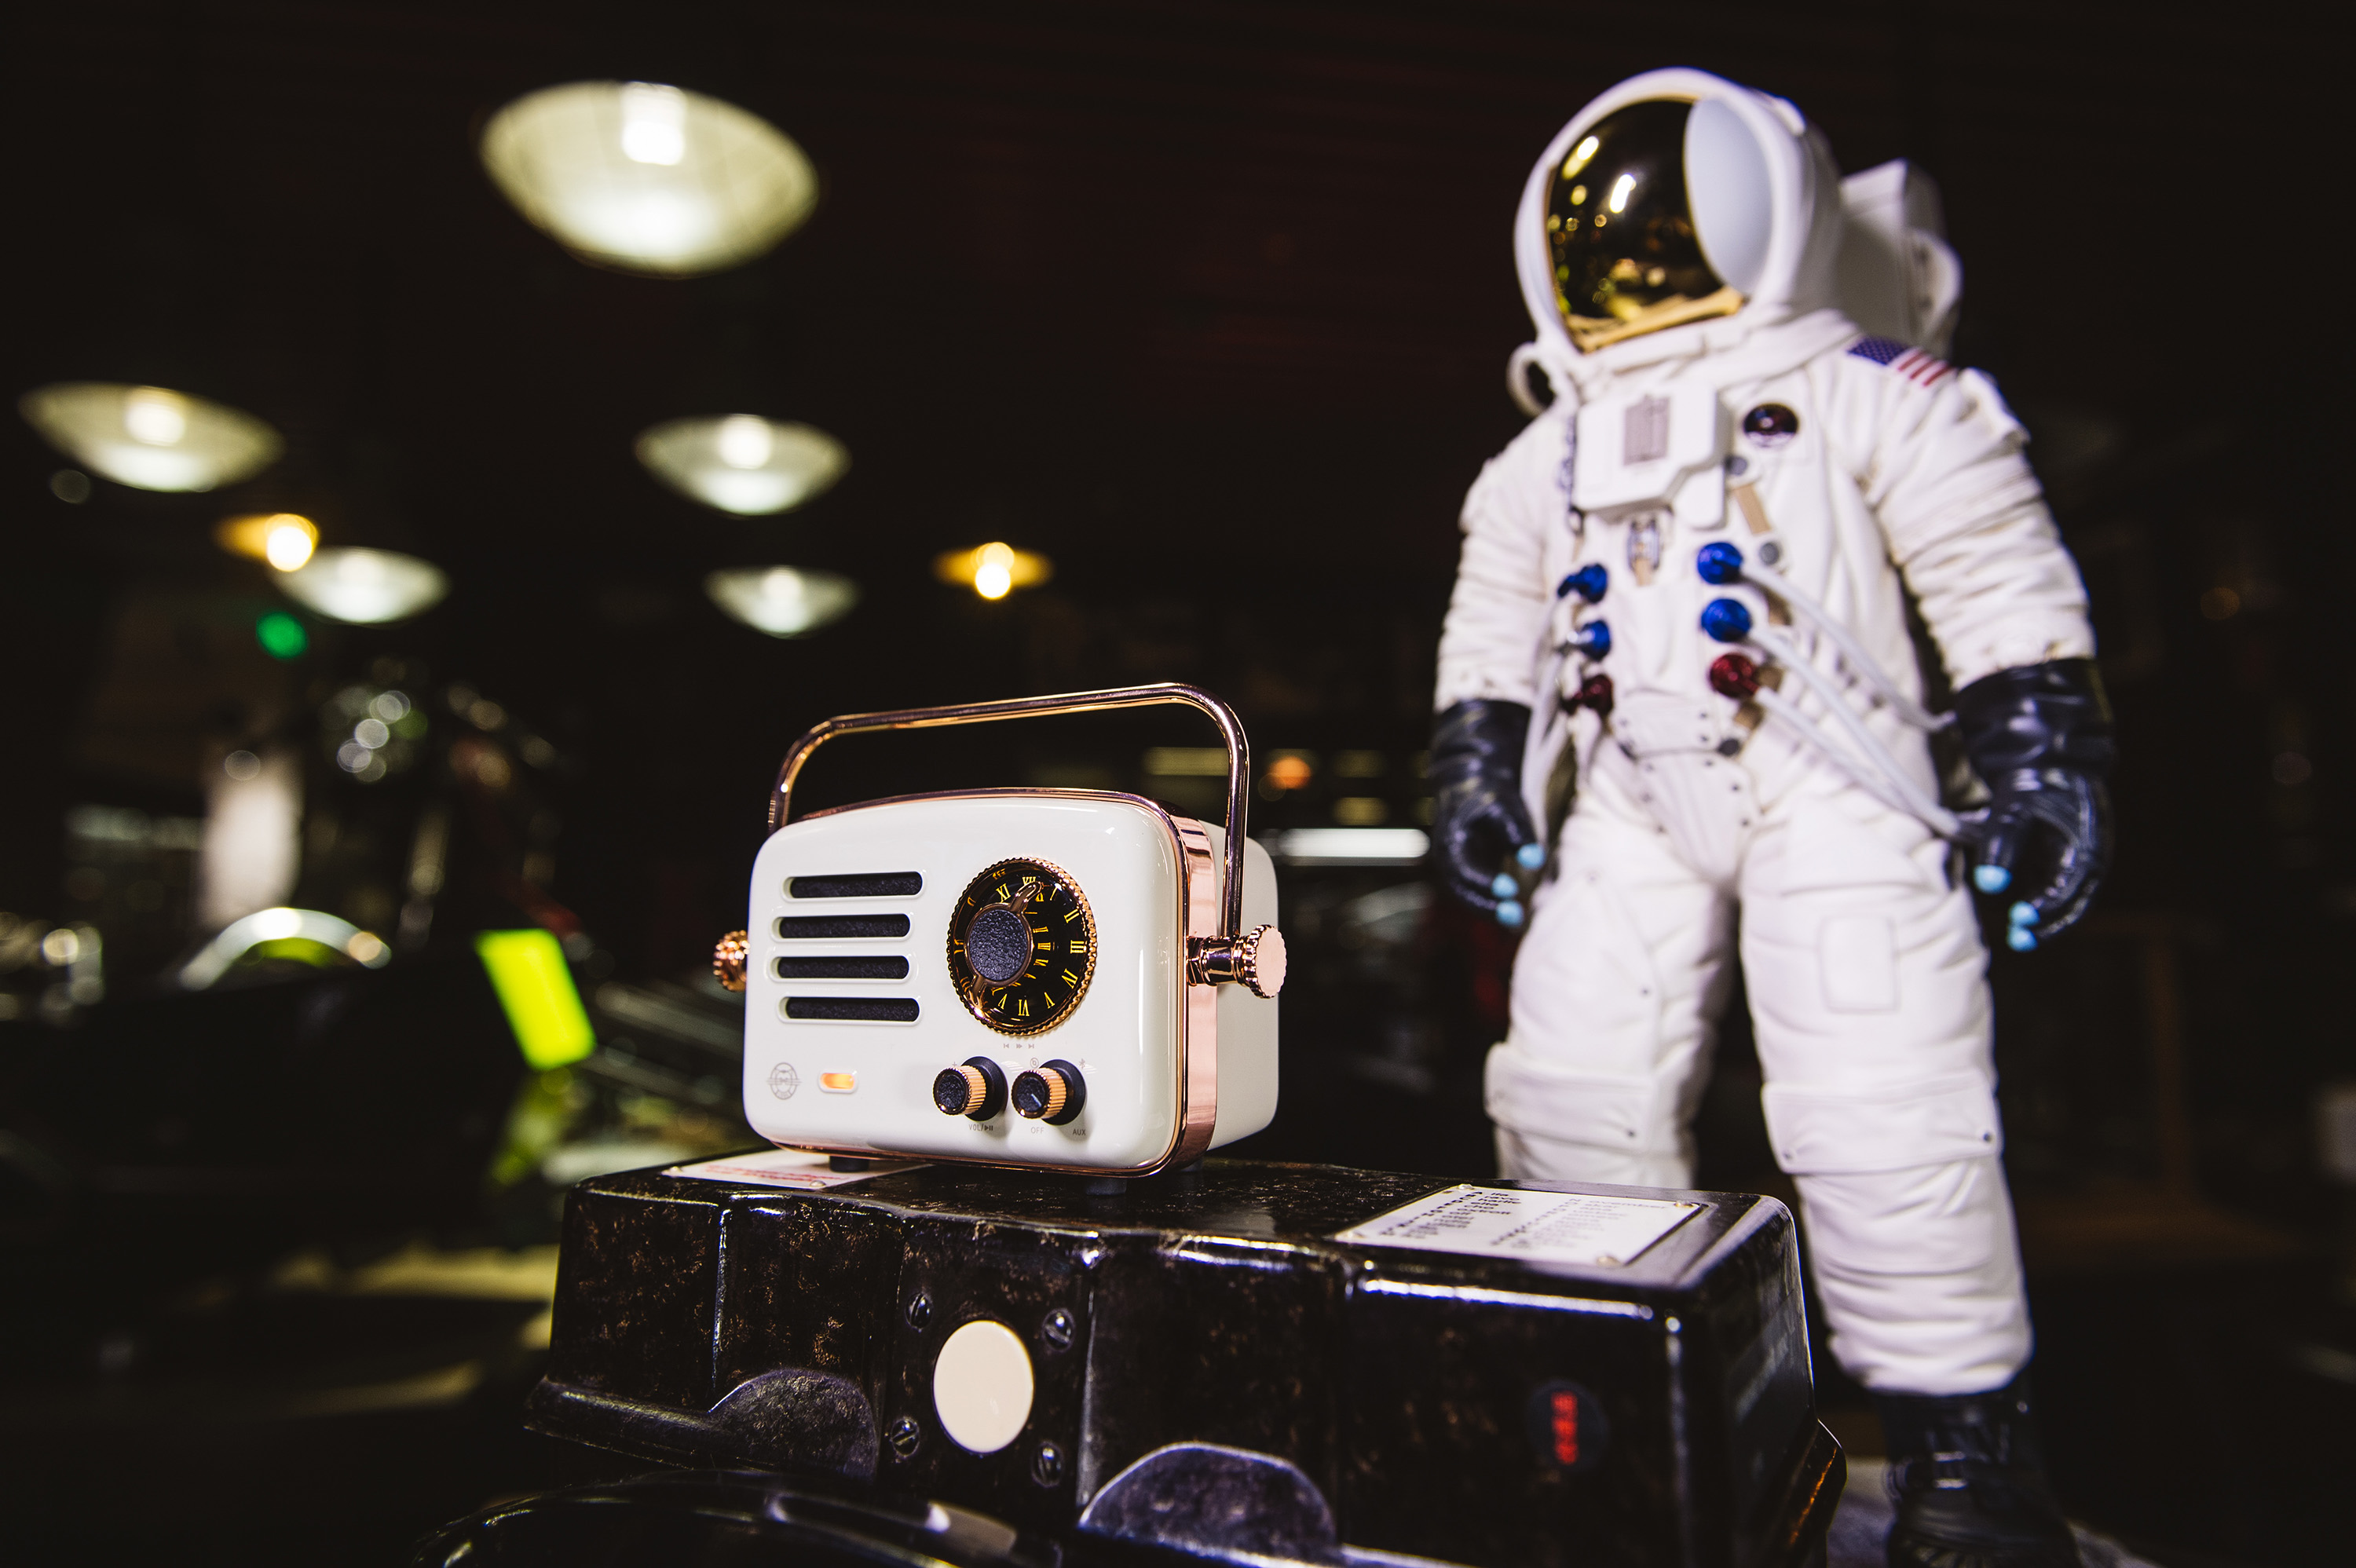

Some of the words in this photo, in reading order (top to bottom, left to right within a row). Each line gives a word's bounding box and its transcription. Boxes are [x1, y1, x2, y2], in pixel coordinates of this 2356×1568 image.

[995, 883, 1011, 903] XI
[1063, 908, 1080, 923] II
[1070, 940, 1085, 954] III
[1061, 968, 1078, 989] IV
[1018, 999, 1030, 1016] VI
